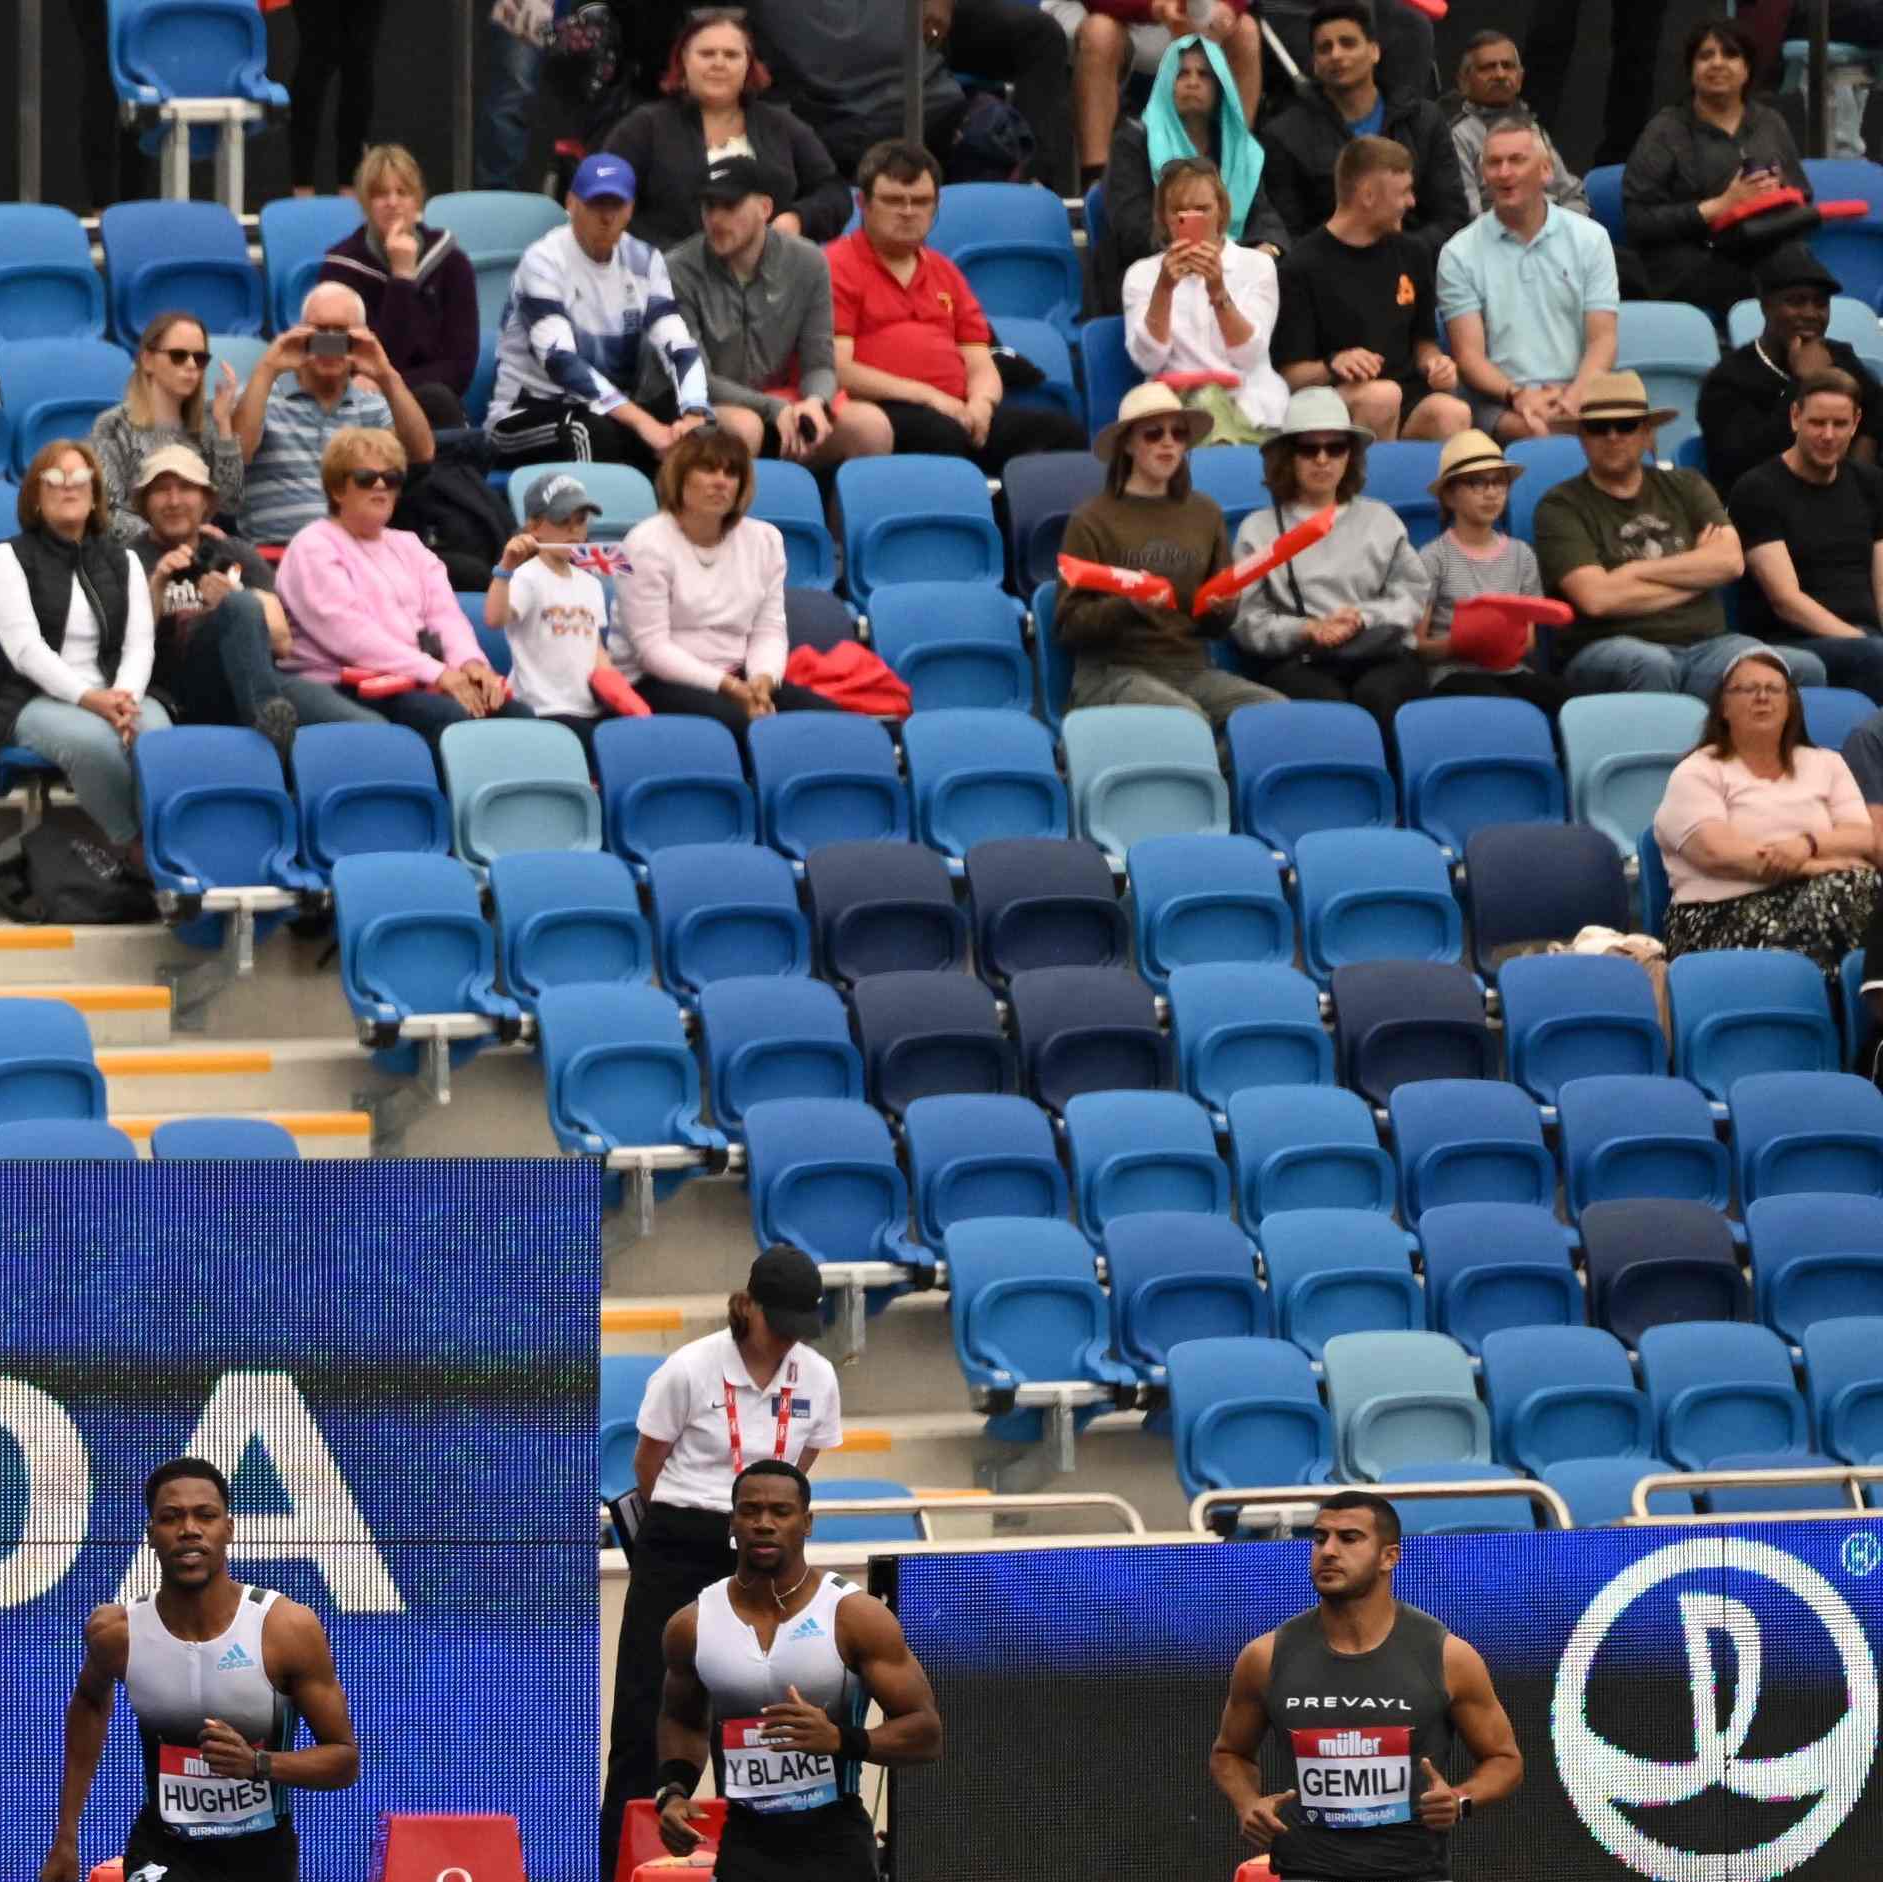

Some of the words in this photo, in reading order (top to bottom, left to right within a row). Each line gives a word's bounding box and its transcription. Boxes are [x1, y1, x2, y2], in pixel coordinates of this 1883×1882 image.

[1286, 1696, 1411, 1710] PREVAYL
[1319, 1731, 1382, 1756] müller
[729, 1759, 742, 1786] Y
[748, 1753, 831, 1787] BLAKE
[1303, 1766, 1405, 1796] GEMILI
[164, 1780, 266, 1812] HUGHES
[1325, 1810, 1395, 1823] BIRMINGHAM
